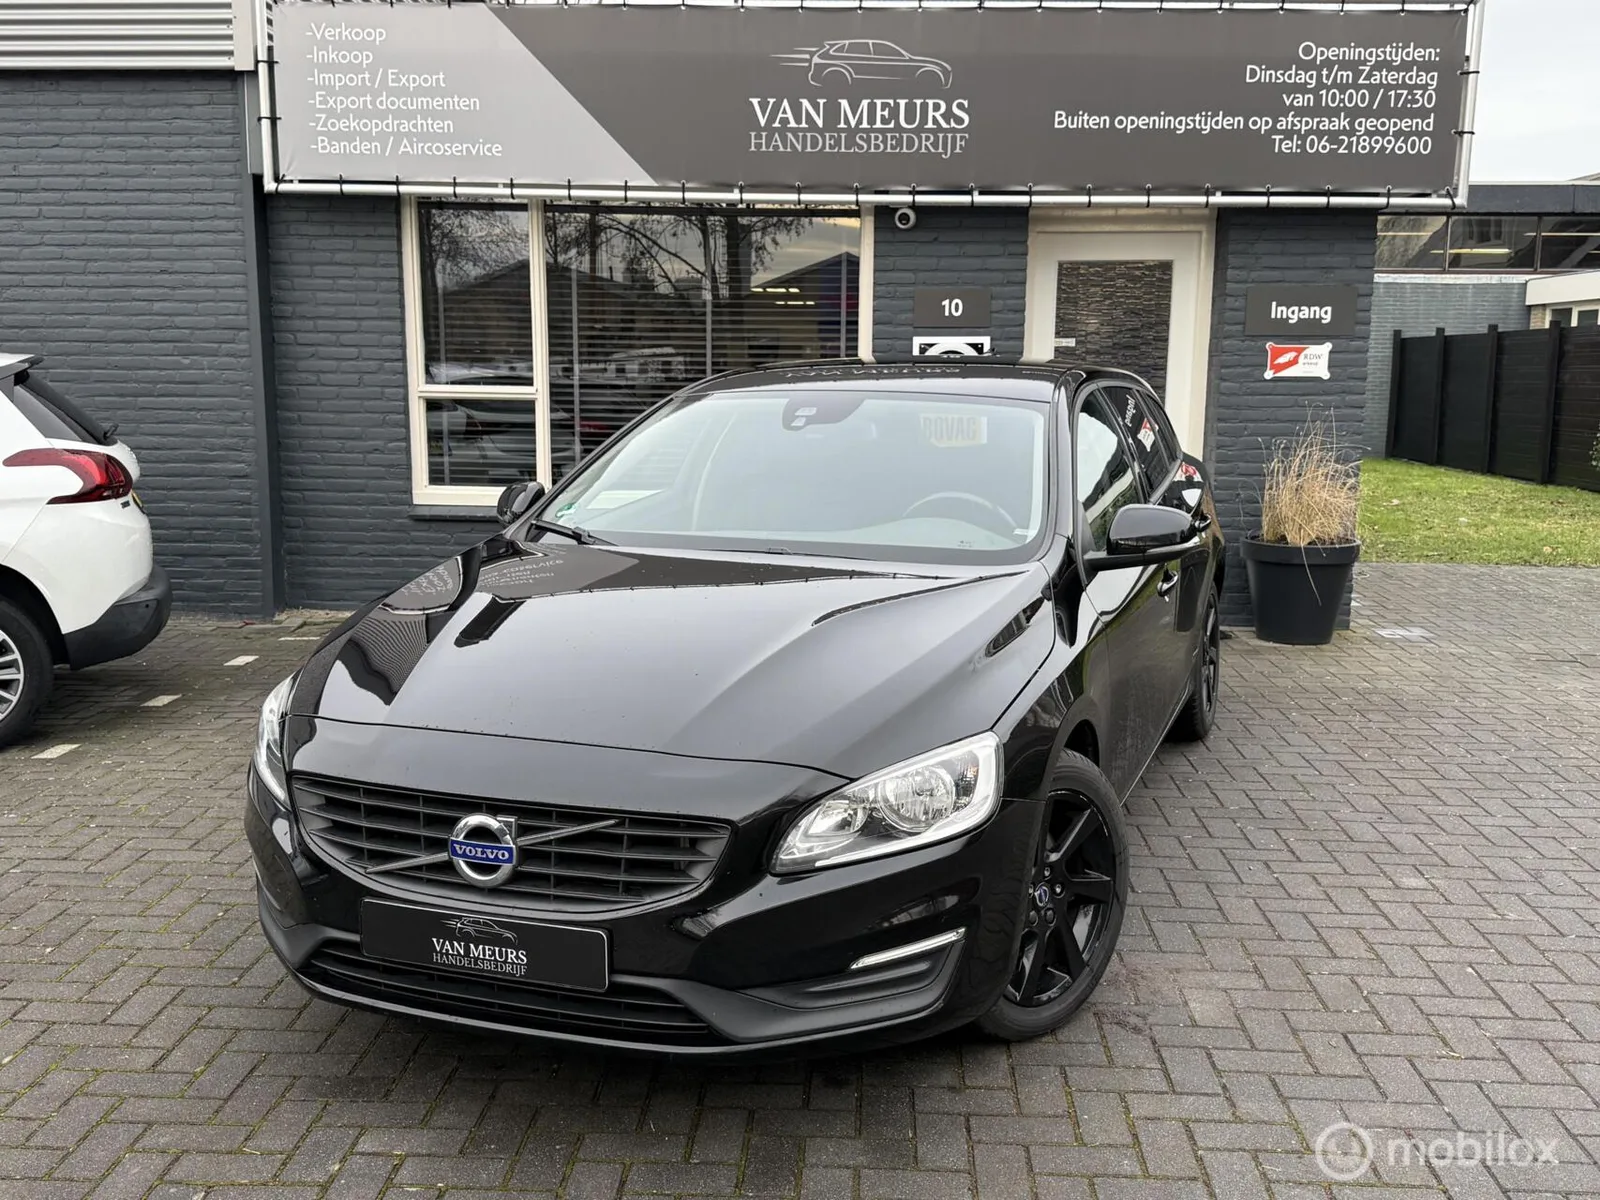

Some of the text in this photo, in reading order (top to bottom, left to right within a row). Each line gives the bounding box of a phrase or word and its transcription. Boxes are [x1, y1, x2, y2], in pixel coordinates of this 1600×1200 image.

[305, 22, 386, 45] -Verkoop
[306, 44, 373, 68] -Inkoop
[1298, 41, 1440, 65] Openingstijden:
[307, 68, 446, 91] -Import / Export
[1245, 64, 1438, 89] Dinsdag t/m Zaterdag
[308, 91, 480, 113] -Export documenten
[1283, 88, 1436, 109] van 10:00 / 17:30
[309, 113, 454, 136] -Zoekopdrachten
[749, 98, 970, 129] VAN MEURS
[1054, 110, 1434, 135] Buiten openingstijden op afspraak geopend
[310, 136, 502, 156] -Banden / Aircoservice
[749, 132, 968, 159] HANDELSBEDRIJF
[1271, 135, 1432, 154] Tel: 06-21899600
[941, 299, 963, 316] 10
[1271, 301, 1332, 324] Ingang
[453, 843, 509, 860] VOLVO
[432, 937, 527, 964] VAN MEURS
[433, 952, 527, 976] HANDELSBEDRIJF
